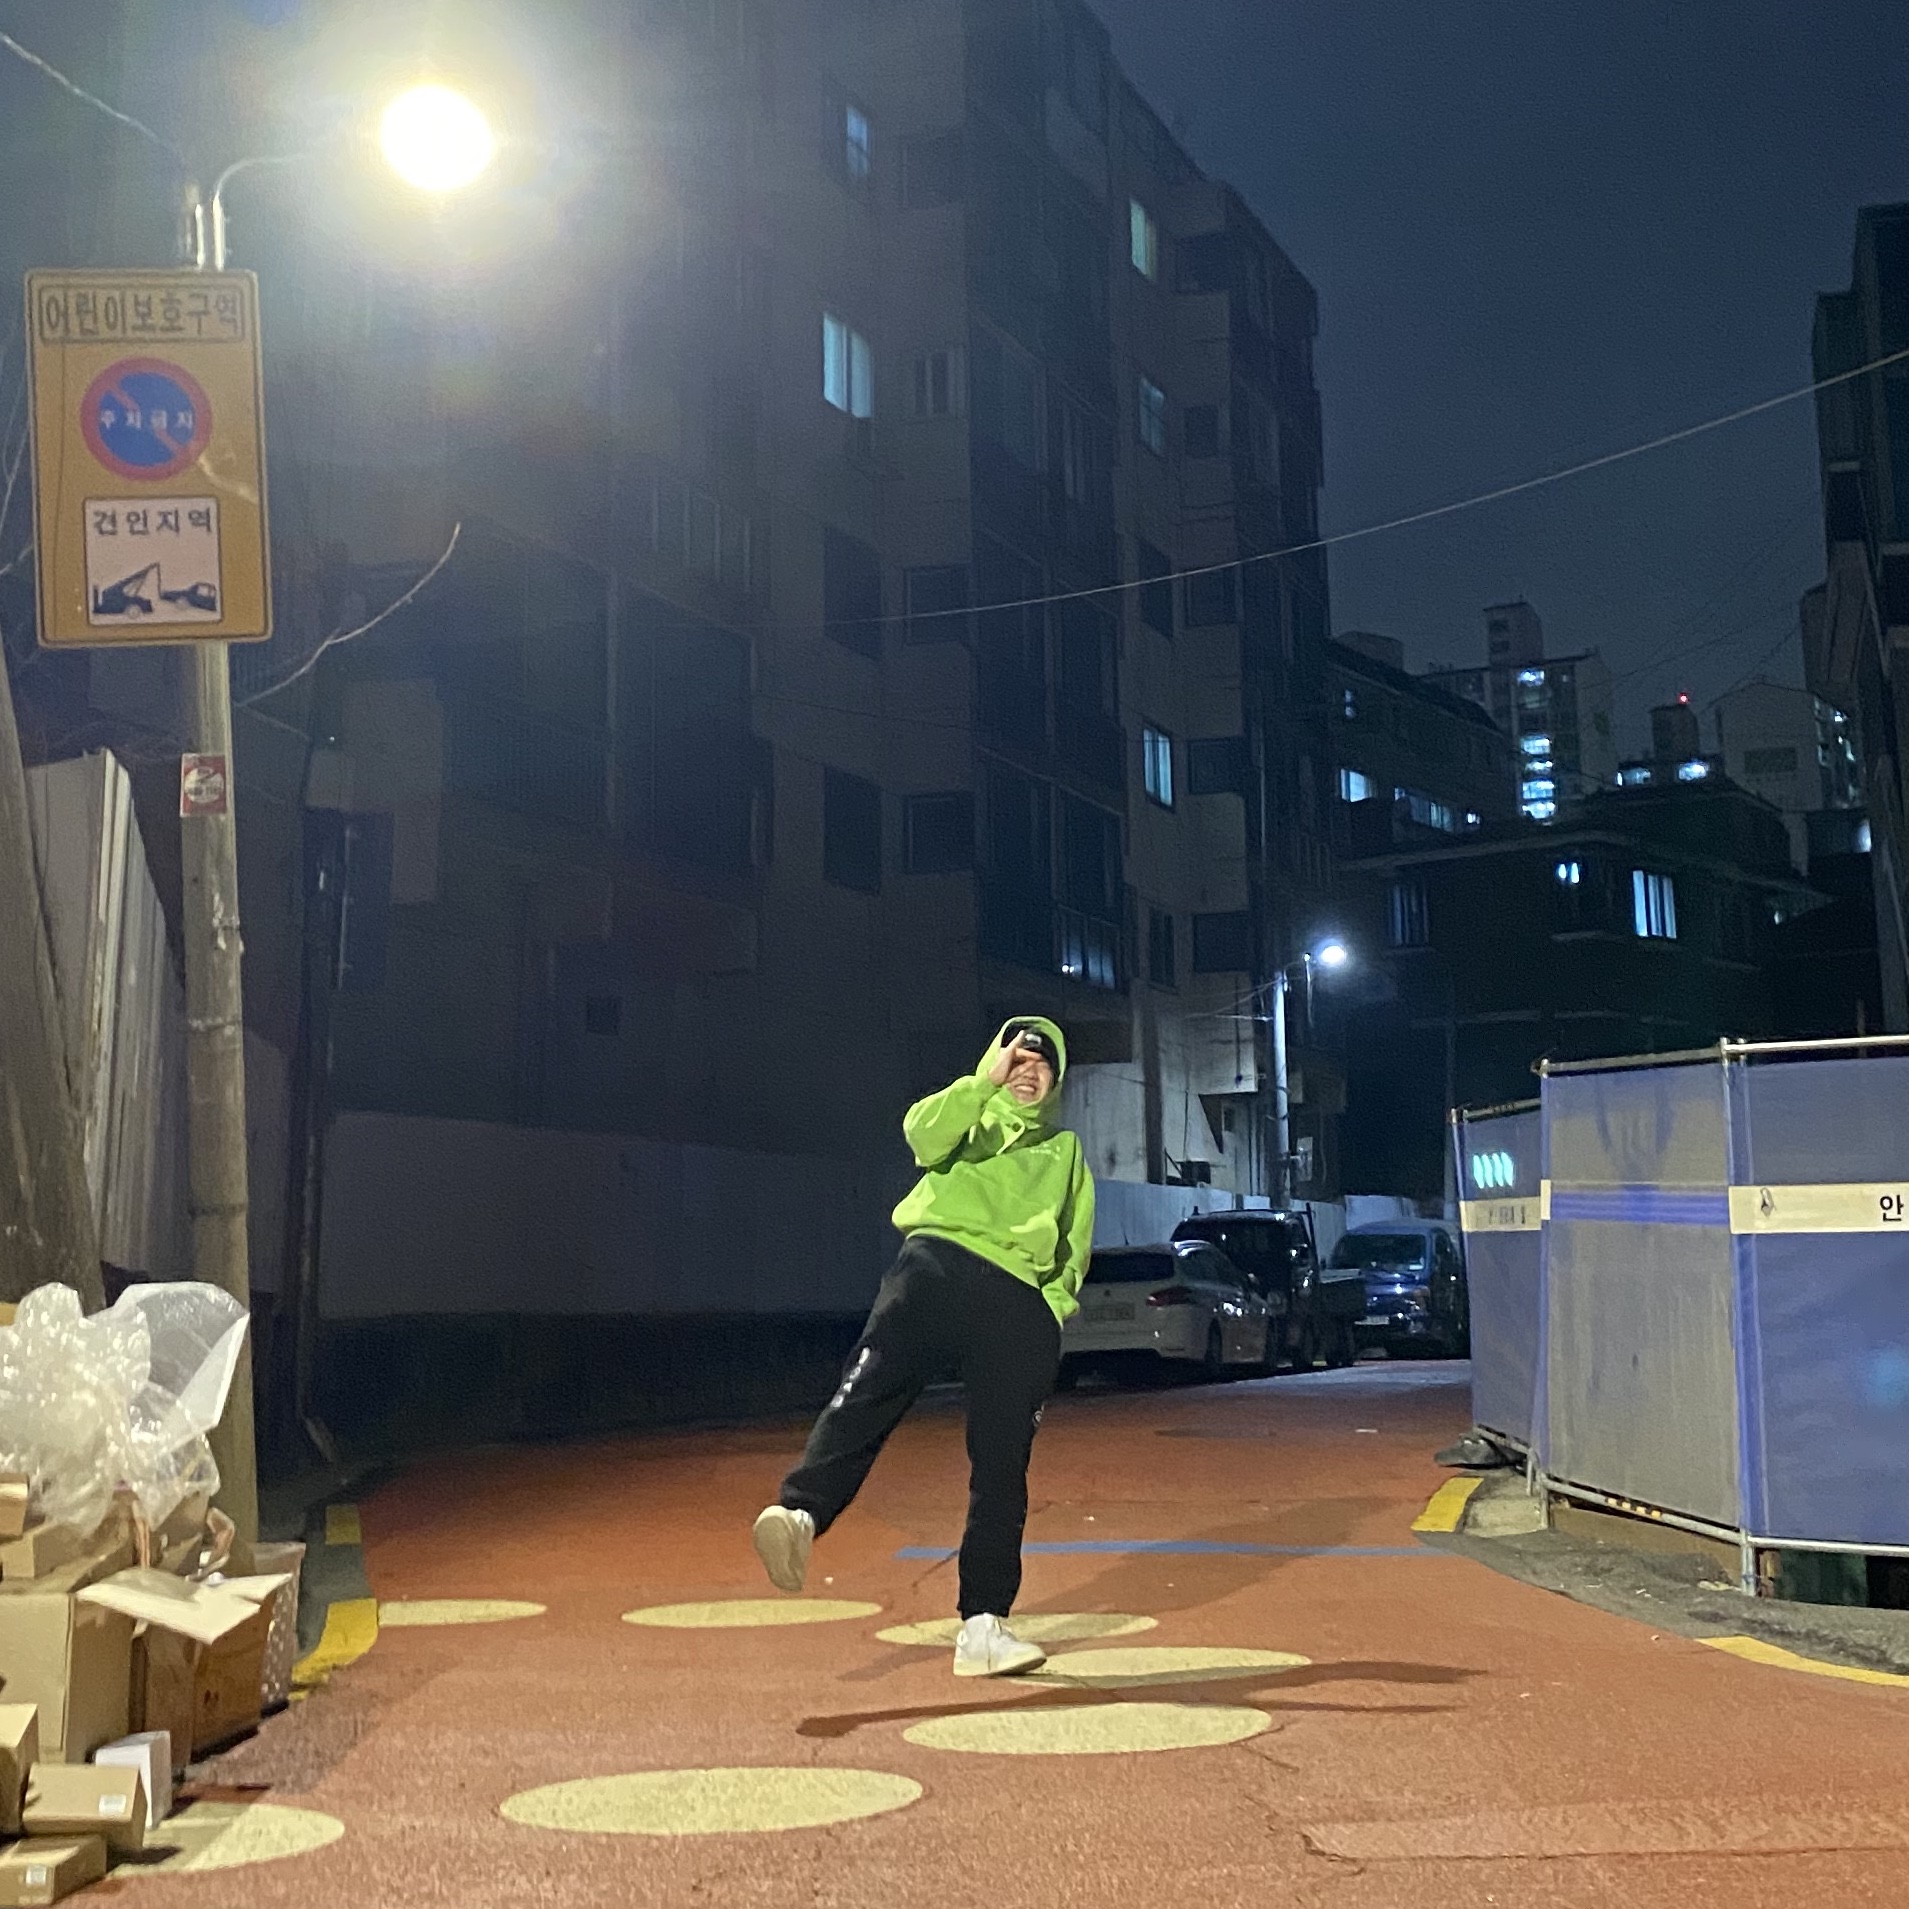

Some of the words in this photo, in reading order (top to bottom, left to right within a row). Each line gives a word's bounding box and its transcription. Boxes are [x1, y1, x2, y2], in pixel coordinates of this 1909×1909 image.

[46, 291, 237, 335] 어린이보호구역
[94, 507, 211, 535] 견인지역
[1879, 1194, 1904, 1222] 안
